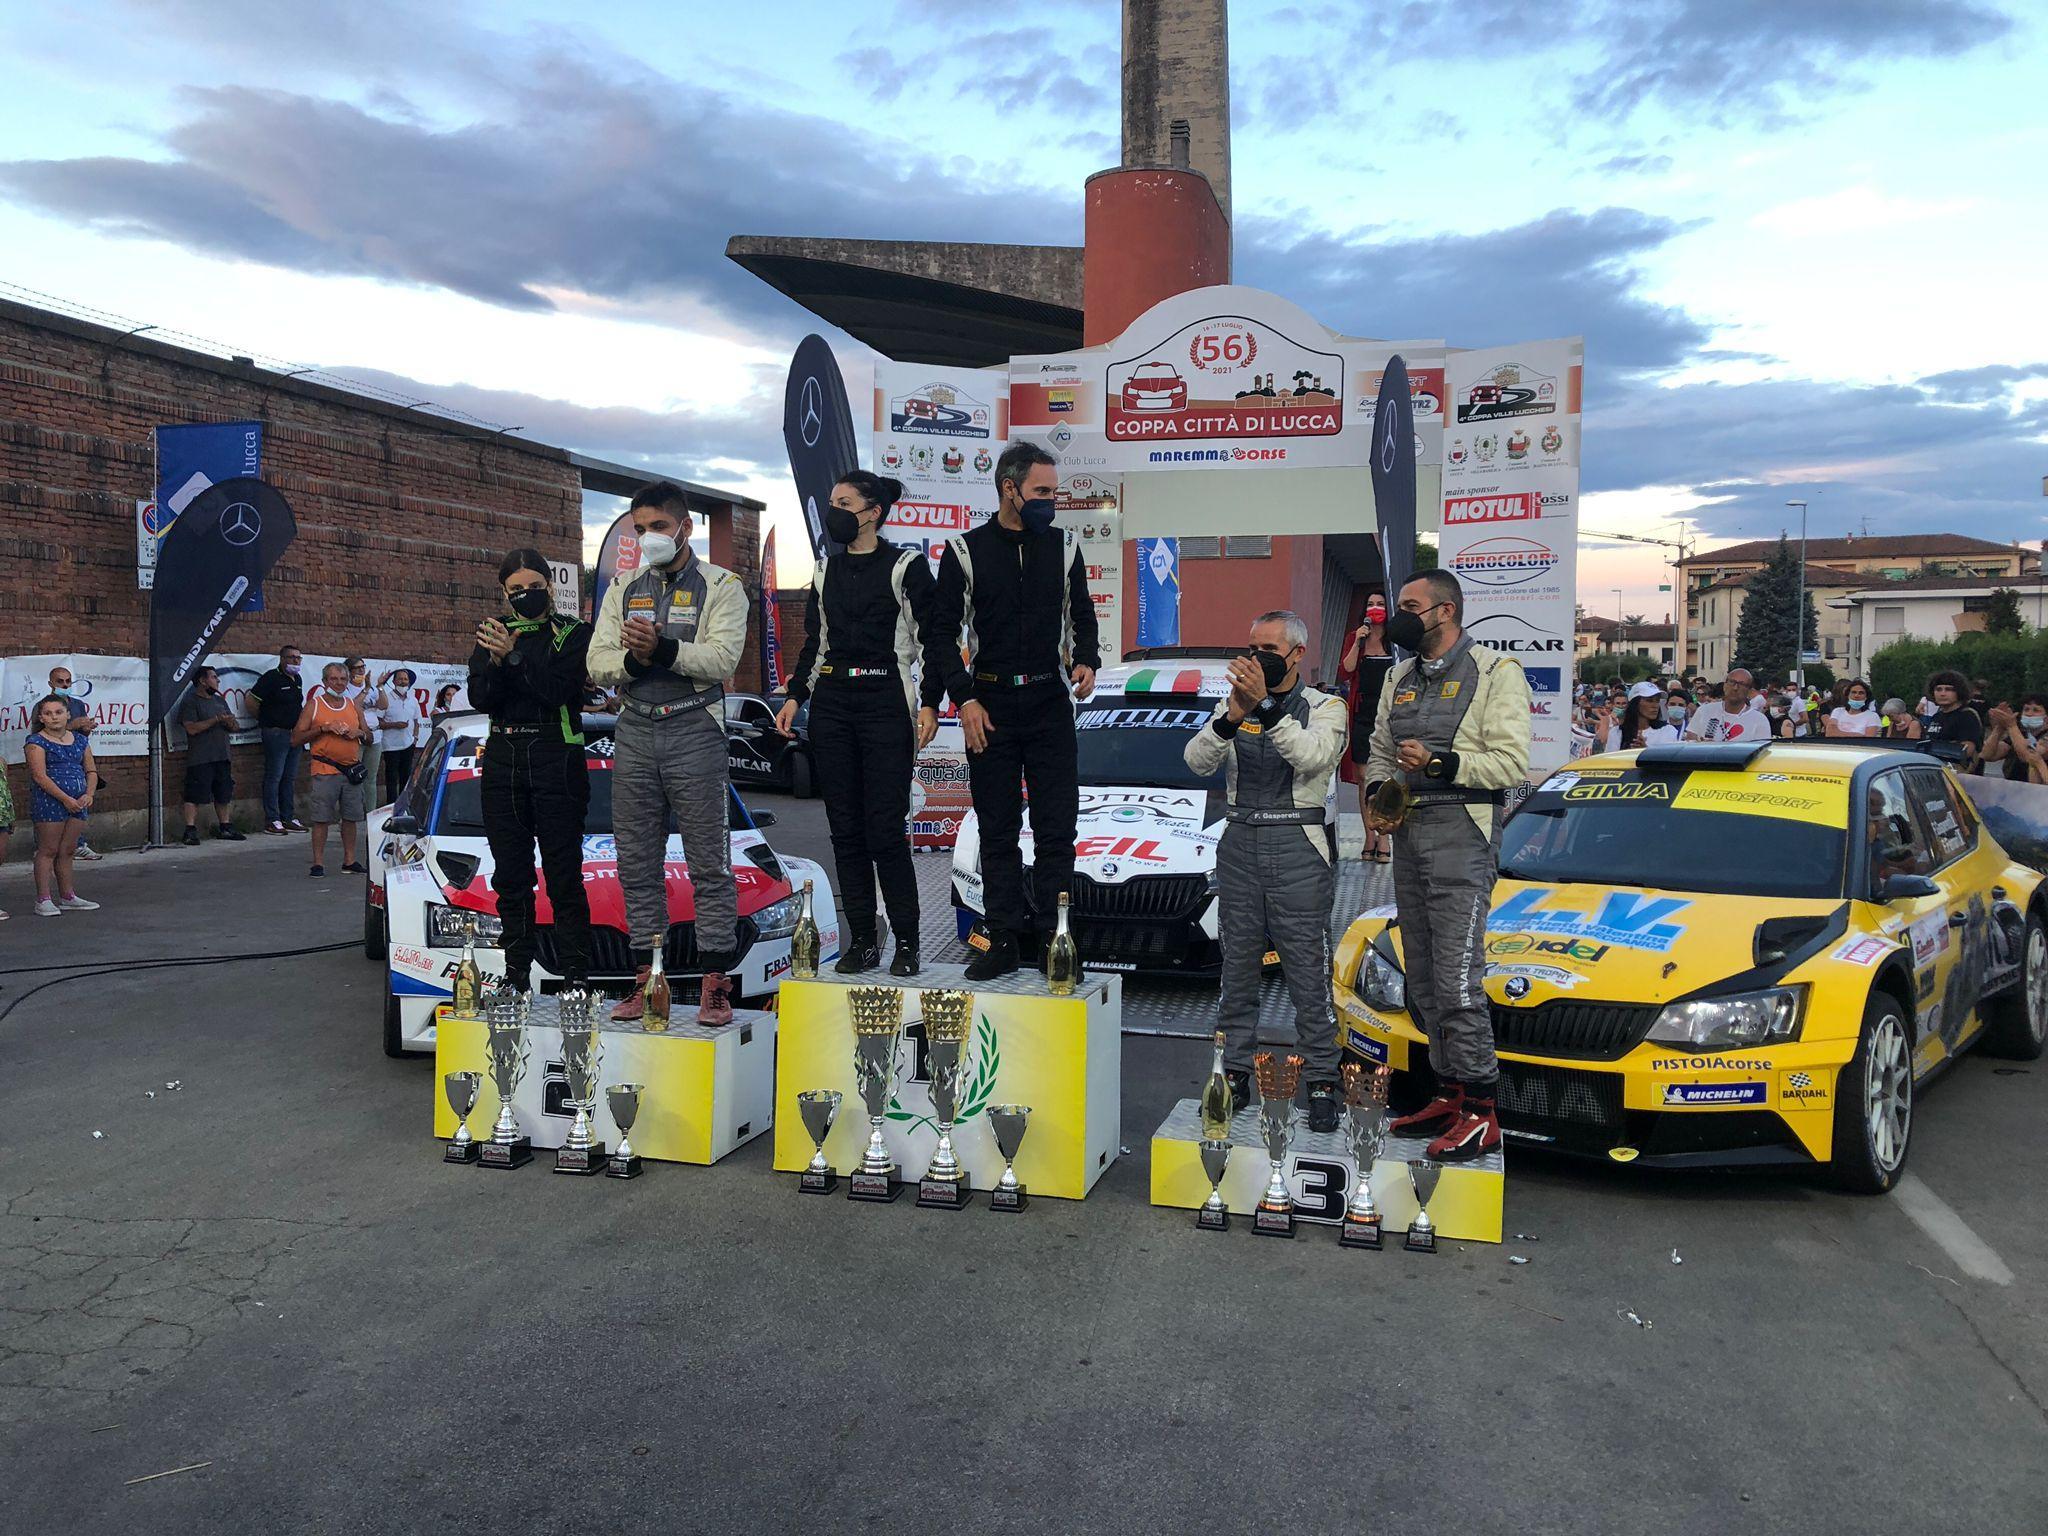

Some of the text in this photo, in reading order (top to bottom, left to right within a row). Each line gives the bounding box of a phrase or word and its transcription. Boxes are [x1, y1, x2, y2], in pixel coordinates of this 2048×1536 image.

[1202, 334, 1242, 362] 56
[1515, 407, 1553, 415] LUCCHESI
[1114, 414, 1337, 436] COPPA CITTÀ DI LUCCA
[951, 429, 987, 437] LUCCHESI
[1056, 432, 1071, 441] ACI
[241, 431, 257, 475] Lucca
[1063, 456, 1107, 466] Club Lucca
[1076, 478, 1089, 489] 56
[1445, 486, 1500, 497] main sponsor
[1448, 498, 1526, 521] MOTUL
[557, 589, 577, 599] VIZIO
[172, 607, 227, 683] GUIDI CAR
[100, 728, 122, 737] prodotti
[458, 757, 471, 768] 4
[1550, 779, 1564, 790] 2
[1791, 775, 1844, 785] BARDAHL
[1563, 782, 1670, 801] GIMA
[1682, 788, 1824, 810] AUTOSPORT
[1128, 858, 1168, 868] POWER
[1466, 895, 1483, 949] SPORT
[1460, 949, 1473, 1007] RENAULT
[1531, 967, 1572, 981] TROPHY
[1353, 1037, 1381, 1056] MICHELIN
[1652, 1057, 1773, 1071] PISTOIAcorse
[1686, 1088, 1755, 1100] MICHELIN
[1781, 1088, 1828, 1100] BARDAHL
[1291, 1156, 1352, 1227] 3
